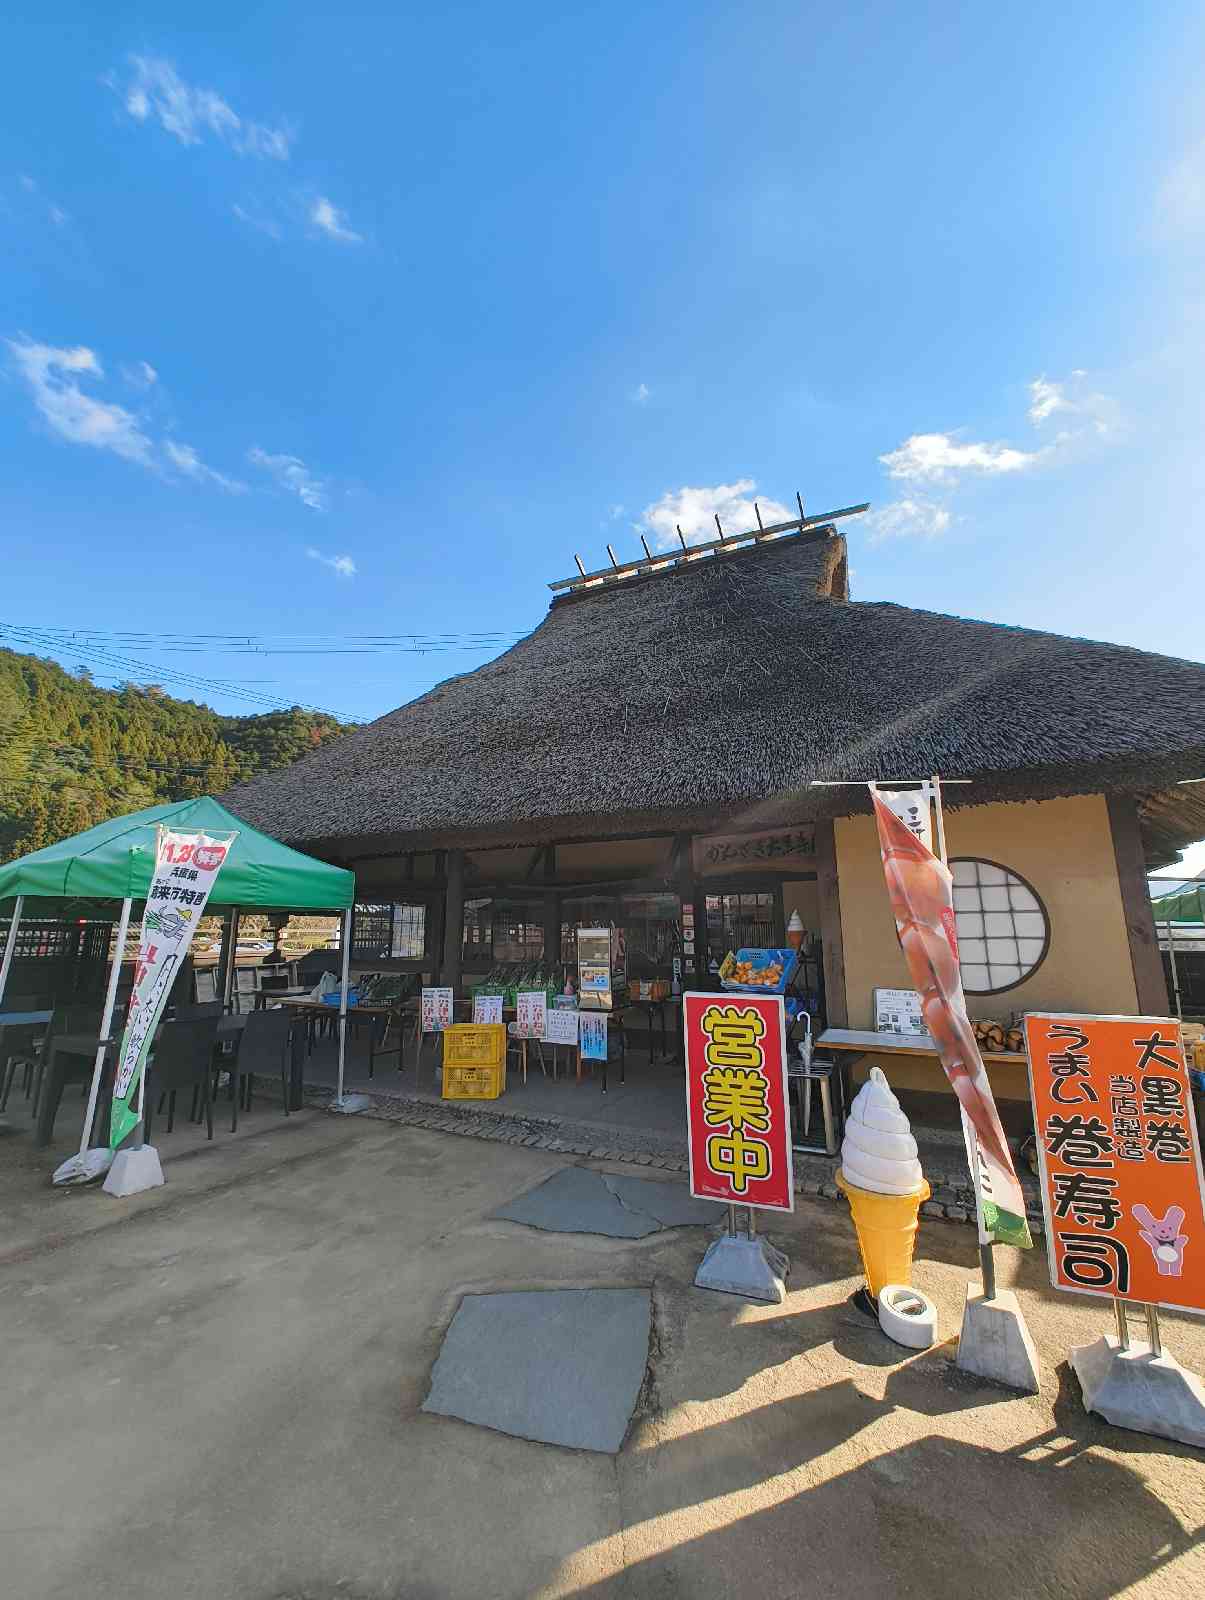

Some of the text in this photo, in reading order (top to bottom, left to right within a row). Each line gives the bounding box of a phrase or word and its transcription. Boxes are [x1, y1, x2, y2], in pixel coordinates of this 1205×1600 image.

[702, 1006, 771, 1192] 営業中
[1047, 1024, 1130, 1293] うまい巻寿司
[1110, 1074, 1146, 1162] 当店製造
